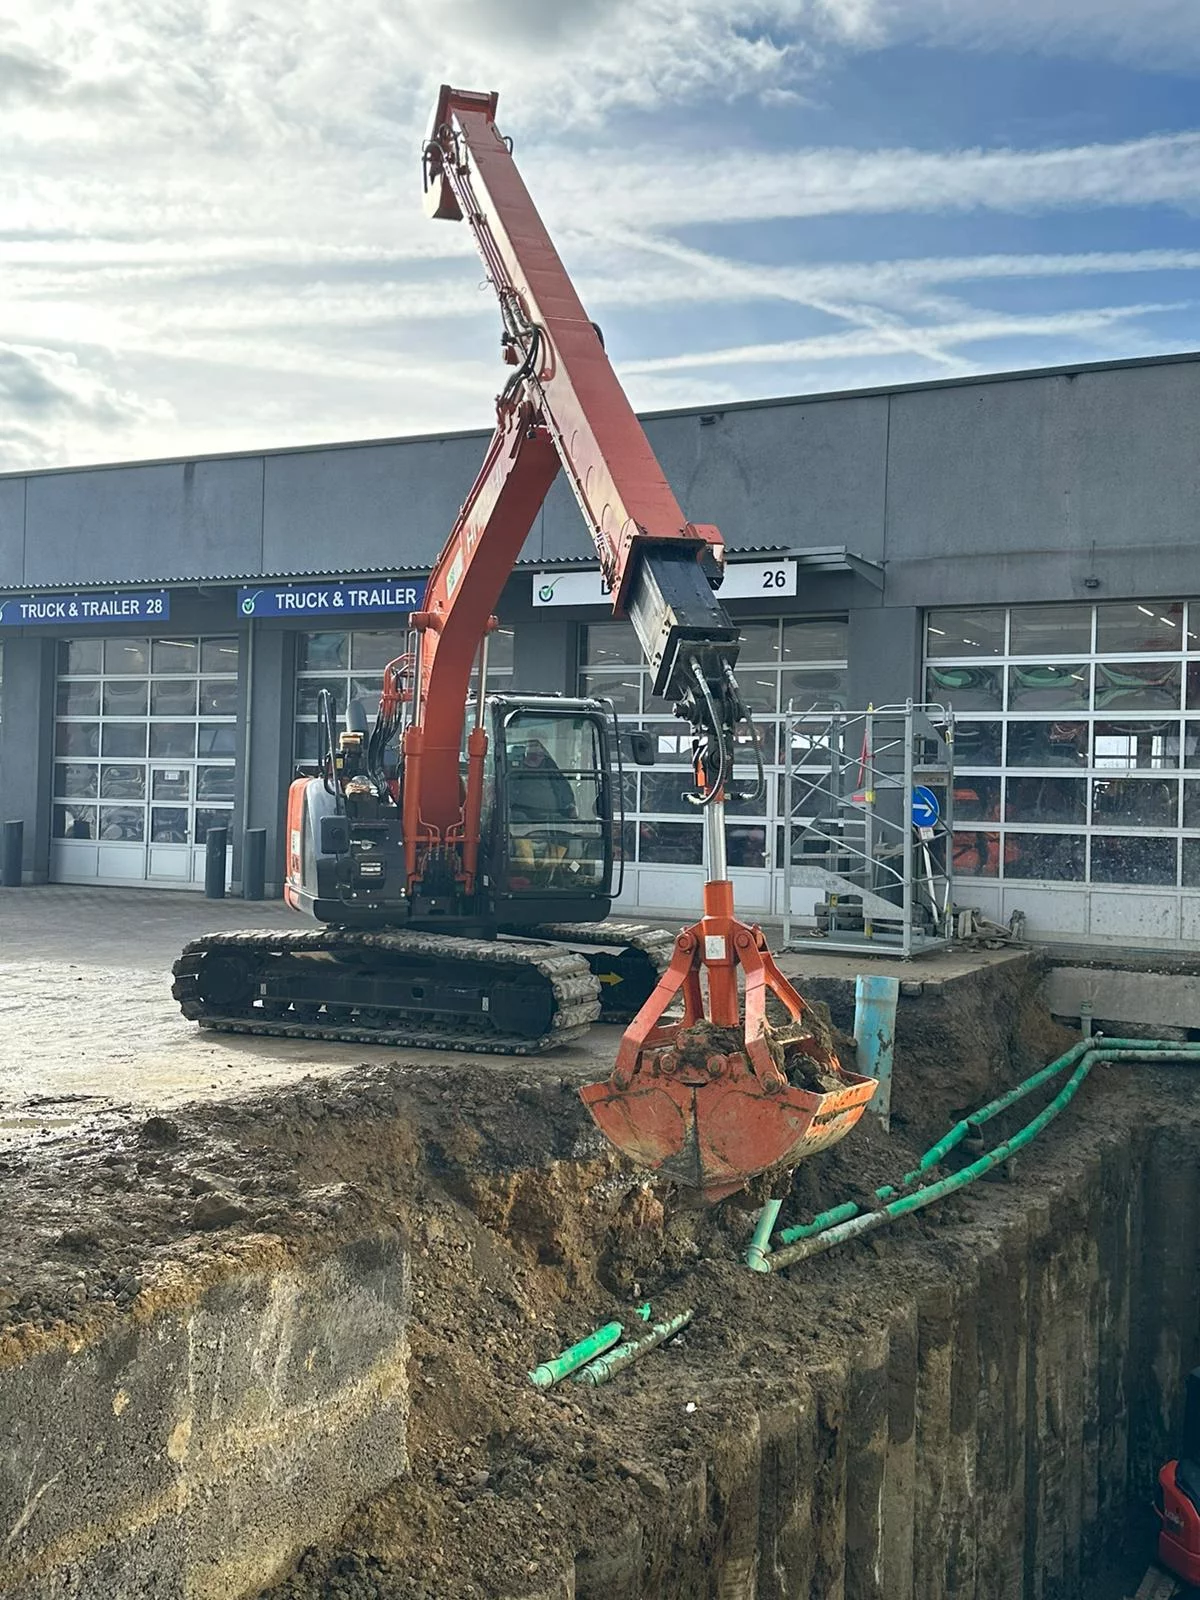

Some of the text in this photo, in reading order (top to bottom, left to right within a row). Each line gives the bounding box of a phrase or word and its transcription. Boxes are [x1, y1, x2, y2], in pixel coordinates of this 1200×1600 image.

[762, 570, 786, 588] 26
[275, 588, 417, 609] TRUCK & TRAILER
[20, 599, 163, 618] TRUCK & TRAILER 28
